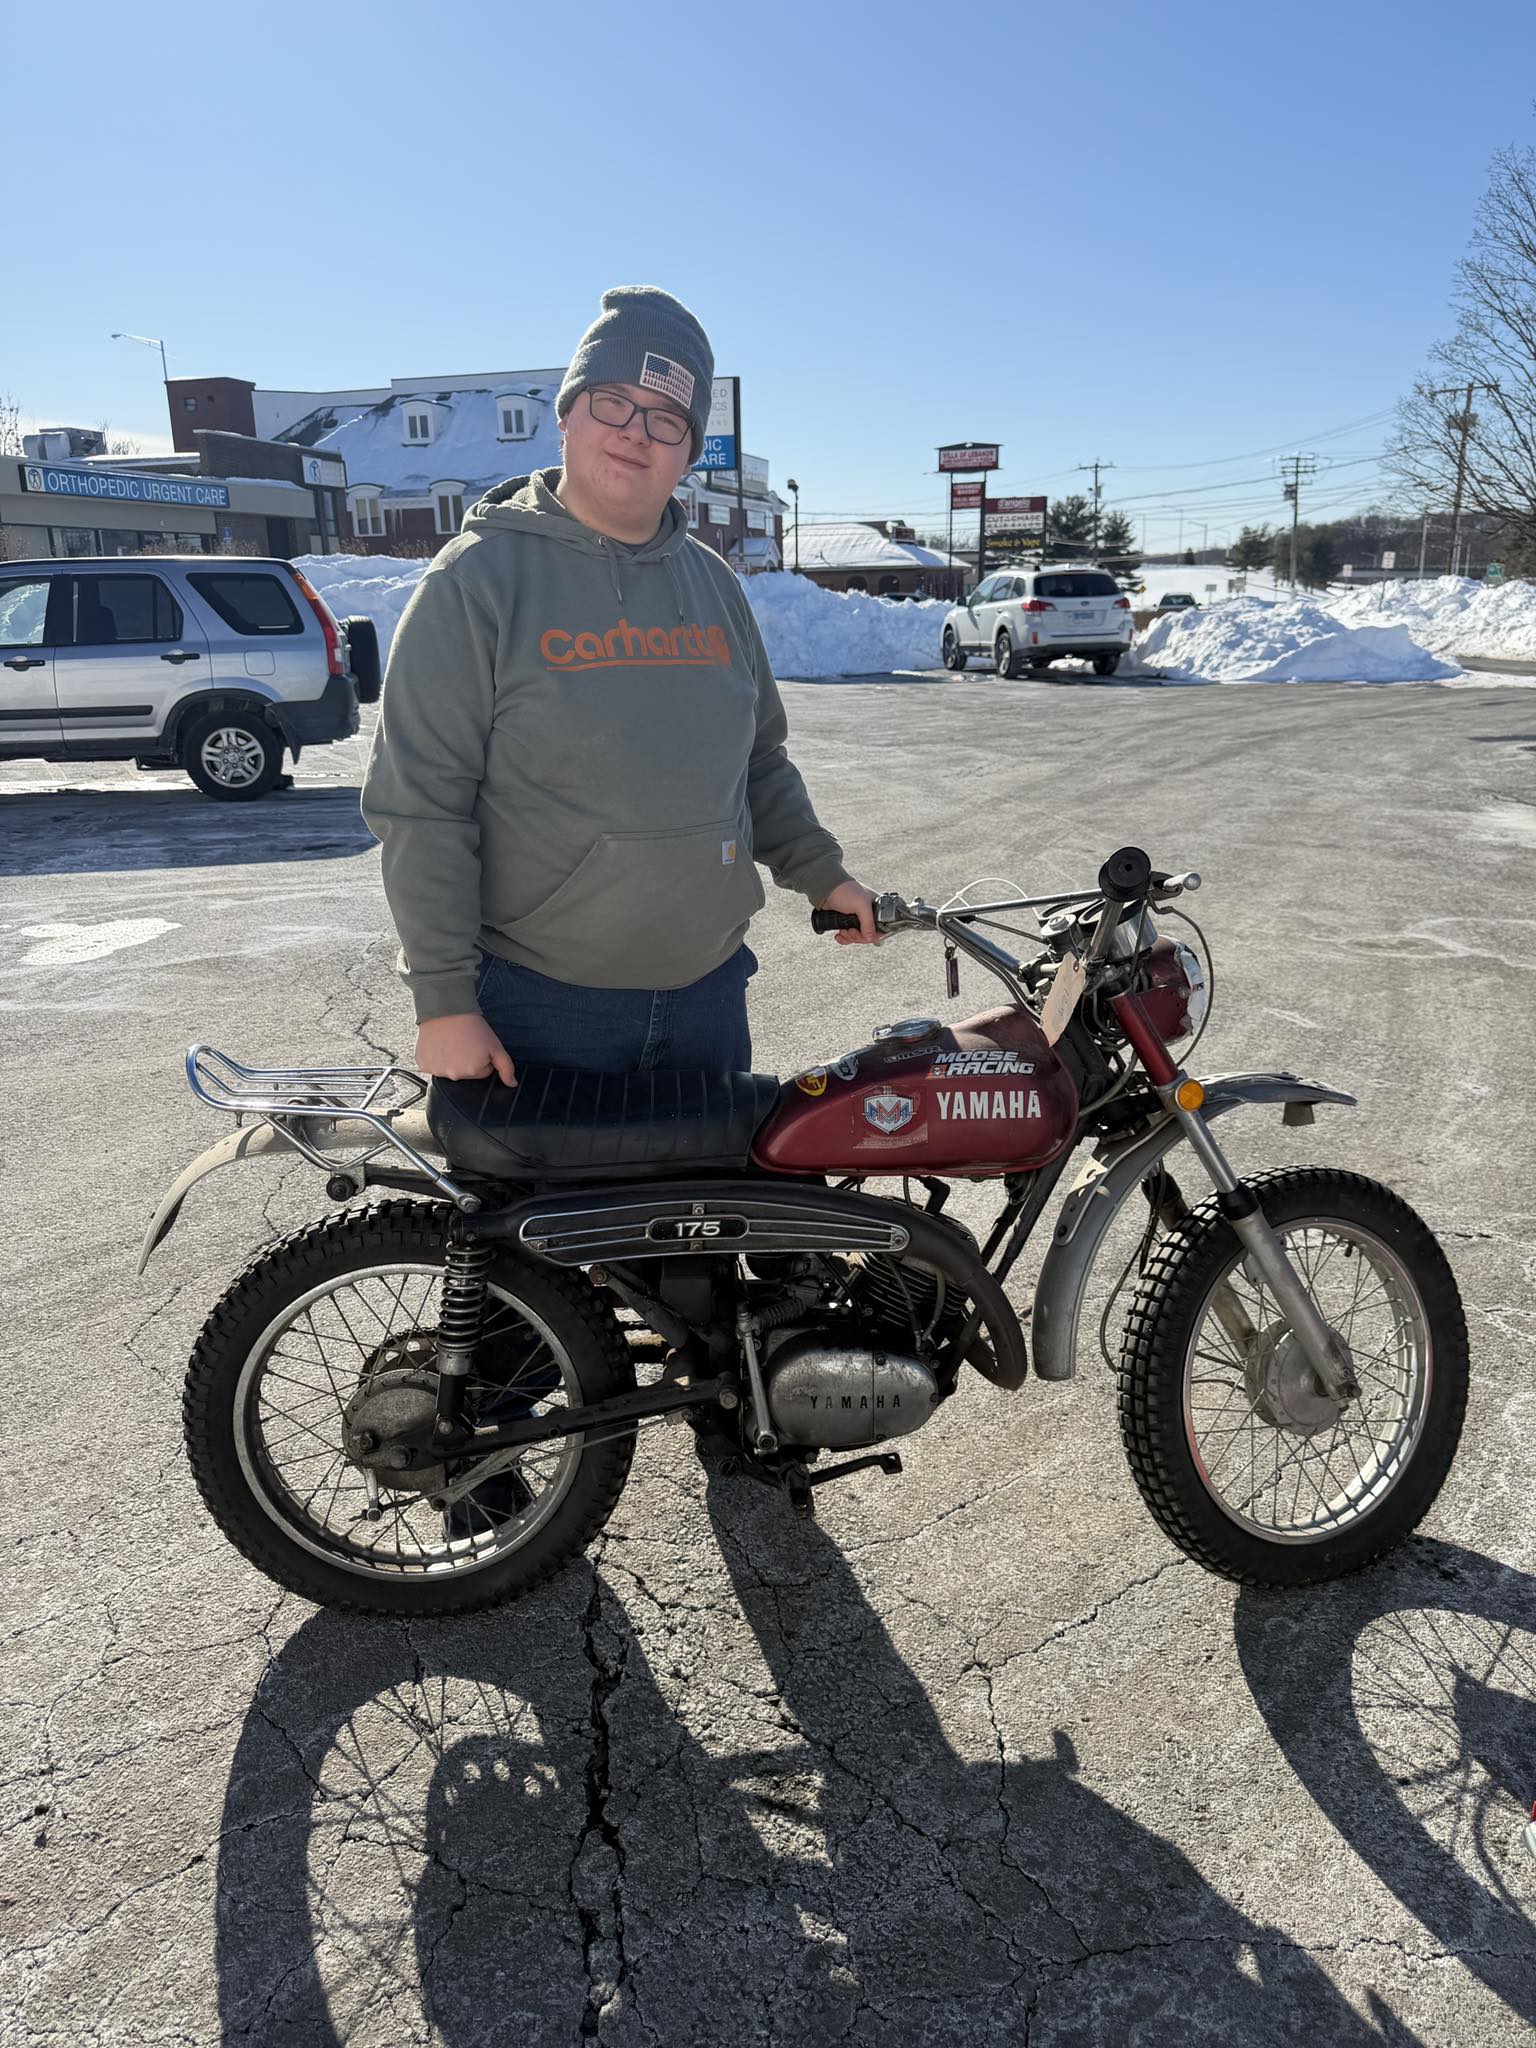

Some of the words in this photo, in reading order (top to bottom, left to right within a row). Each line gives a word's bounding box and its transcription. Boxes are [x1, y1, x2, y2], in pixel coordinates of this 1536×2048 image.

[697, 453, 727, 465] ARE
[49, 472, 140, 498] ORTHOPEDIC
[143, 483, 192, 503] URGENT
[196, 488, 227, 505] CARE
[935, 1050, 1019, 1064] MOOSE
[946, 1061, 1035, 1076] RACING
[936, 1090, 1042, 1120] YAMAHA
[675, 1221, 721, 1237] 175
[810, 1395, 901, 1409] YAMAHA
